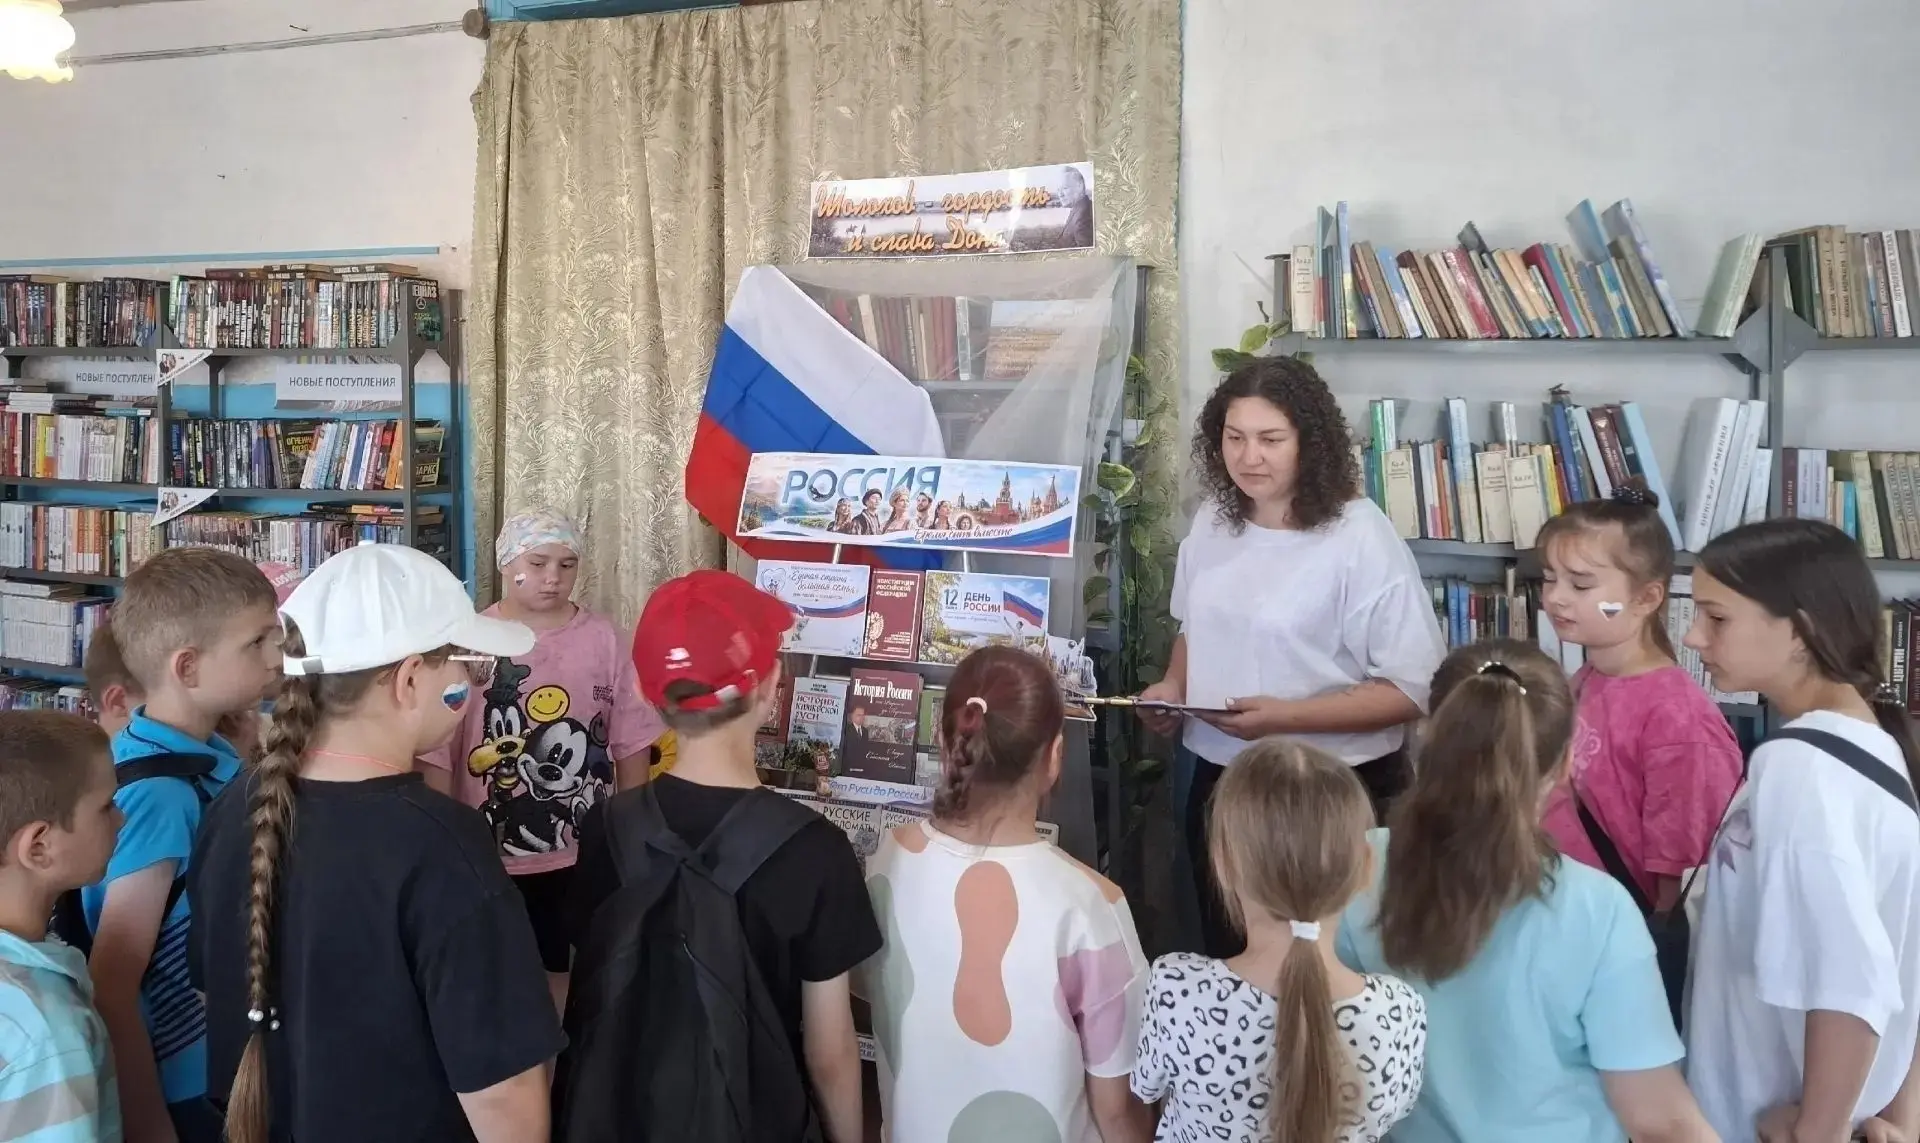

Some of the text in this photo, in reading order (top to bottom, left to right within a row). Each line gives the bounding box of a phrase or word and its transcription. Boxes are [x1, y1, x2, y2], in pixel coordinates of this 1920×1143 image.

[814, 180, 916, 218] Шолохов
[848, 233, 864, 251] и
[872, 217, 935, 250] слава
[76, 373, 105, 382] НОВЫЕ
[289, 377, 396, 387] НОВЫЕ ПОСТУПЛЕНИЯ
[782, 466, 942, 503] РОССИЯ
[944, 589, 959, 605] 12
[964, 592, 991, 602] ДЕНЬ
[963, 602, 1001, 613] РОССИИ
[854, 679, 913, 703] История России
[829, 780, 848, 792] От
[848, 783, 873, 796] Руси
[873, 785, 887, 796] до
[823, 806, 871, 822] РУССКИЕ
[885, 812, 917, 824] РУССКИЕ
